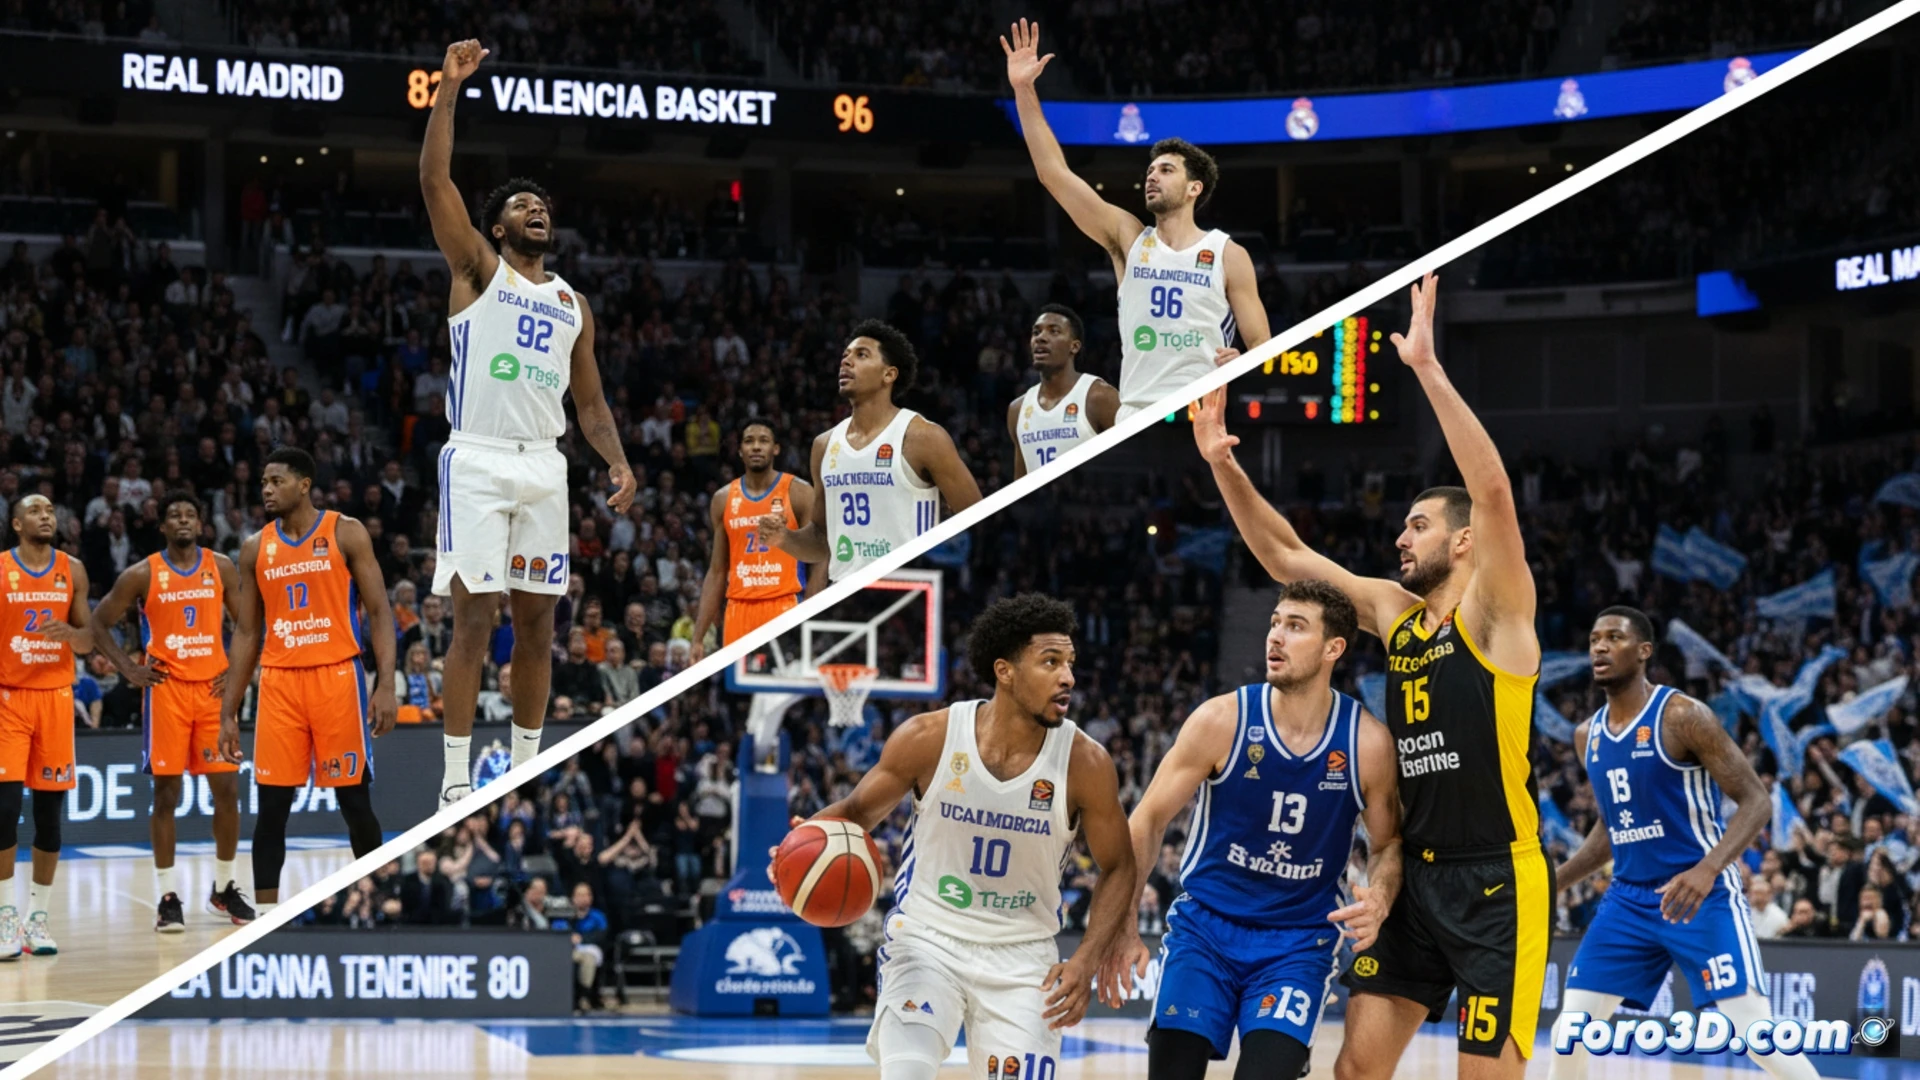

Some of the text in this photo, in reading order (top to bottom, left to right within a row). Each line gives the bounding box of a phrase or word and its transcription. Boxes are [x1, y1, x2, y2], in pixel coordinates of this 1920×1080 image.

[123, 53, 208, 93] REAL
[217, 59, 344, 101] MADRID
[466, 88, 481, 98] -
[491, 76, 648, 119] VALENCIA
[656, 86, 776, 125] BASKET
[834, 94, 874, 134] 96
[1836, 252, 1890, 291] REAL
[1150, 286, 1183, 319] 96
[516, 315, 553, 353] 92
[1401, 675, 1431, 725] 15
[68, 764, 136, 822] DE
[1268, 790, 1308, 835] 13
[969, 836, 1011, 878] 10
[487, 955, 530, 999] 80
[1707, 953, 1738, 990] 15
[1273, 986, 1310, 1026] 13
[1467, 996, 1499, 1042] 15
[1024, 1052, 1056, 1080] 10
